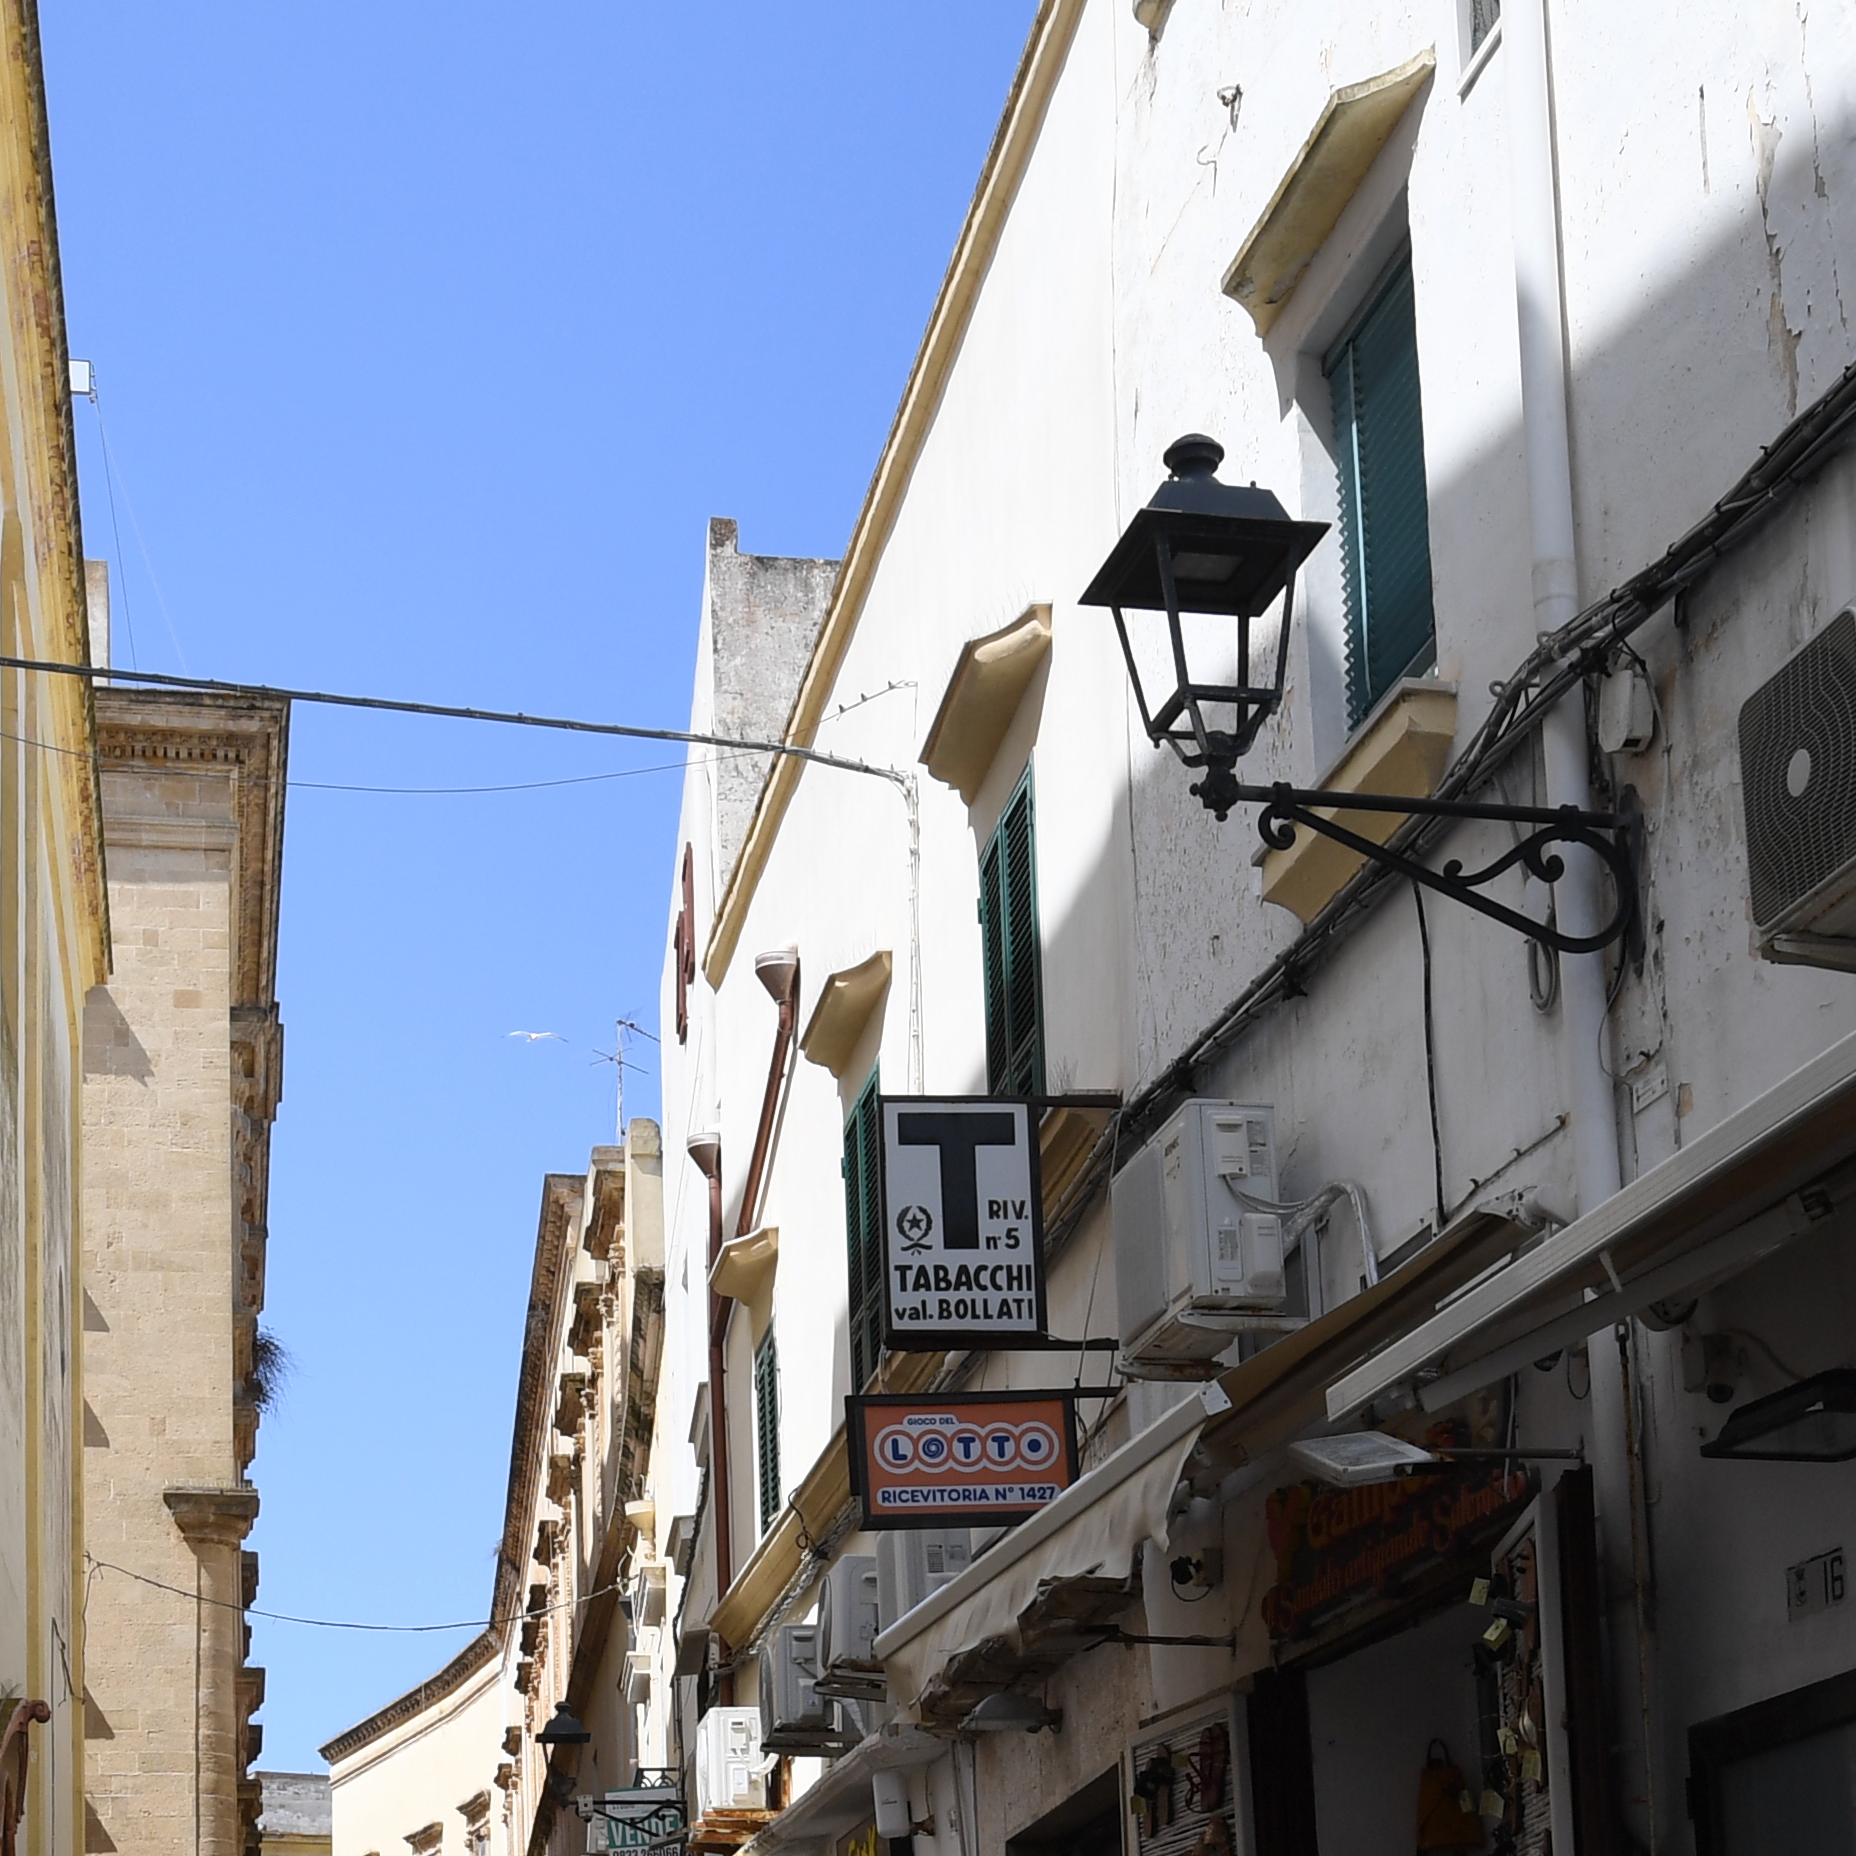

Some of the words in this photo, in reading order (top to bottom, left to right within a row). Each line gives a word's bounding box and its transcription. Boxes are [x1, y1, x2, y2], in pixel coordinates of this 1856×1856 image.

[897, 1112, 1016, 1250] T
[987, 1199, 1029, 1221] RIV.
[894, 1264, 1033, 1292] TABACCHI
[894, 1299, 934, 1321] val.
[937, 1298, 1034, 1320] BOLLATI
[907, 1417, 937, 1426] GIOCO
[938, 1416, 956, 1425] DEL
[881, 1488, 990, 1504] RICEVITORIA
[1019, 1486, 1056, 1500] 1427
[1823, 1555, 1845, 1605] 16
[610, 1815, 675, 1847] VENDE
